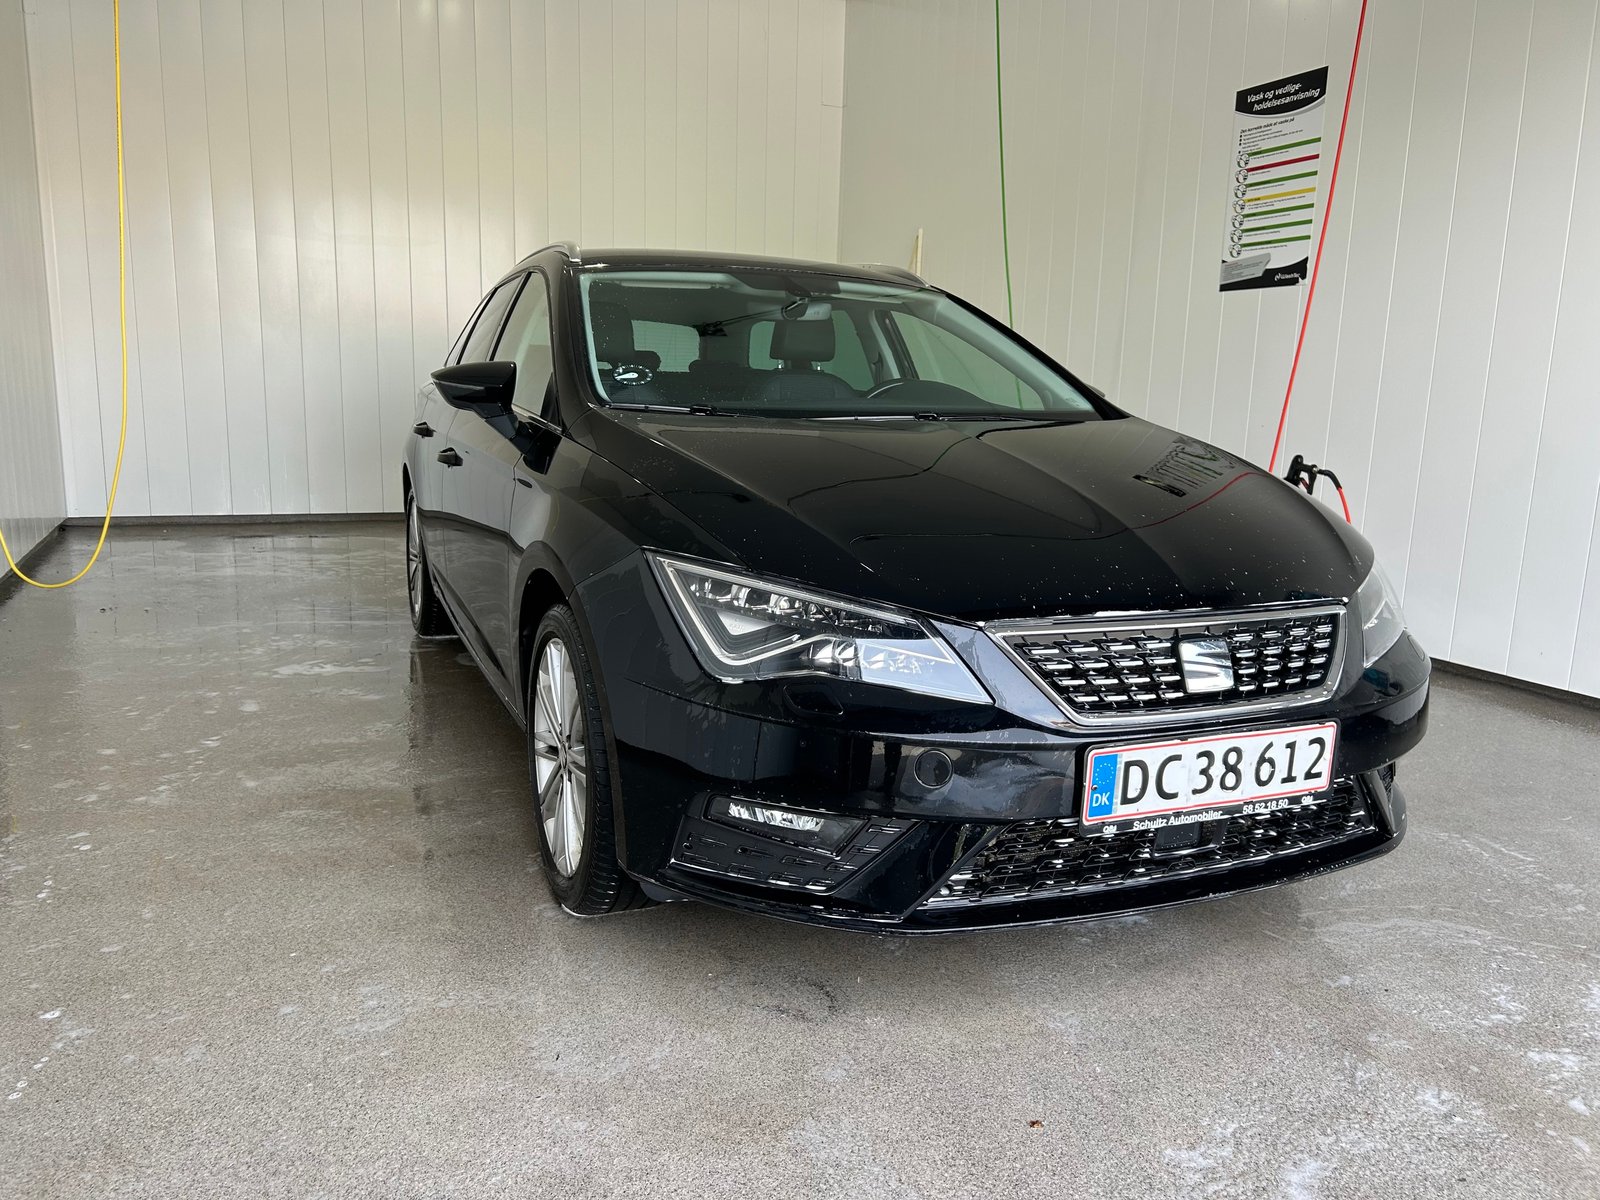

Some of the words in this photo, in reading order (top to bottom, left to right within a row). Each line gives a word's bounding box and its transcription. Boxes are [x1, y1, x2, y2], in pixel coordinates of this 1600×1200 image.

[1247, 91, 1264, 103] Vask
[1264, 89, 1274, 100] og
[1275, 82, 1302, 95] vedlige-
[1253, 88, 1320, 112] holdelsesanvisning
[1120, 753, 1183, 806] DC
[1191, 746, 1243, 796] 38
[1254, 736, 1326, 787] 612
[1092, 791, 1110, 807] DK
[1242, 804, 1254, 814] 58
[1254, 802, 1266, 812] 52
[1266, 800, 1277, 810] 18
[1277, 798, 1289, 808] 50
[1133, 817, 1168, 830] Schultz
[1168, 810, 1222, 826] Automobiler
